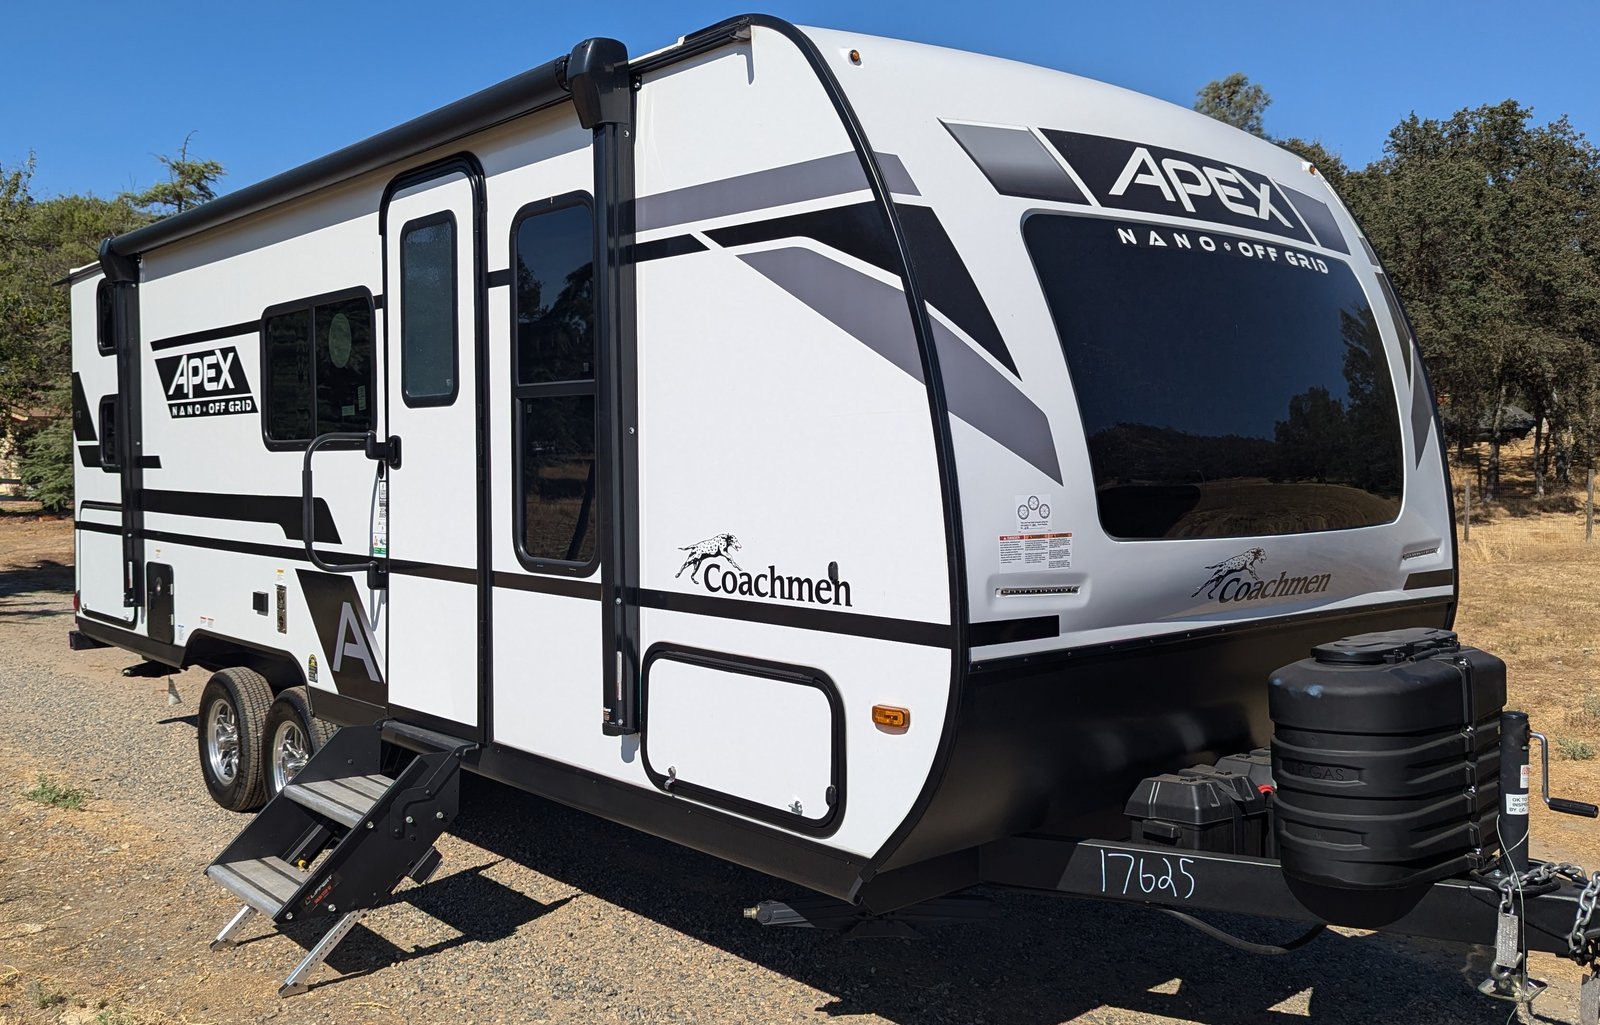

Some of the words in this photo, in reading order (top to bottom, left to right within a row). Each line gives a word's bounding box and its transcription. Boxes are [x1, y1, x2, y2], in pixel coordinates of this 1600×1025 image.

[1108, 146, 1294, 228] APEX
[1117, 227, 1216, 252] NANO
[1237, 241, 1278, 262] OFF
[1284, 250, 1329, 274] GRID
[168, 349, 235, 399] APEX
[172, 404, 201, 416] NANO
[208, 402, 226, 414] OFF
[228, 399, 252, 412] GRID
[703, 563, 853, 607] Coachmen
[1218, 571, 1331, 603] Coachmen
[332, 601, 382, 683] A
[1309, 765, 1345, 781] GAS
[1100, 849, 1195, 899] 17625
